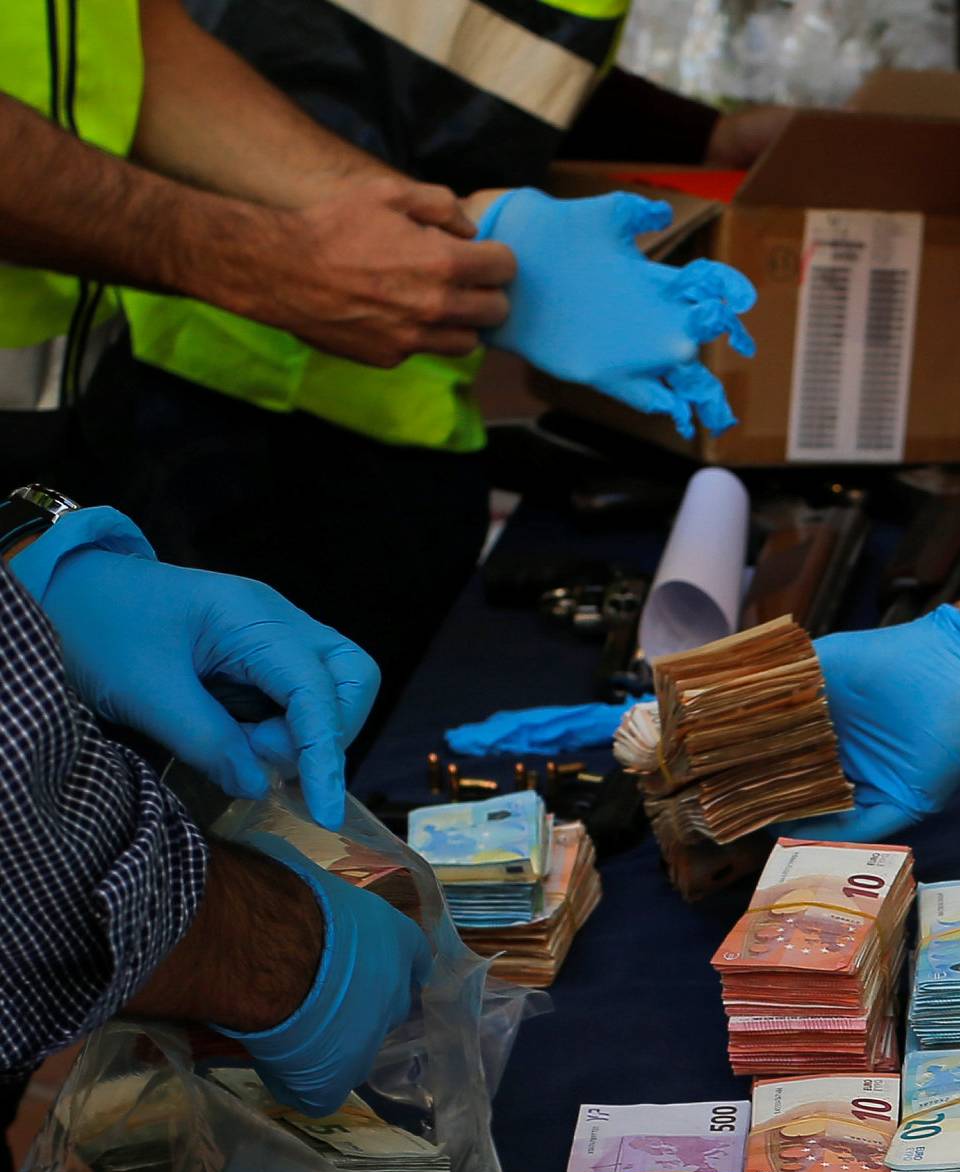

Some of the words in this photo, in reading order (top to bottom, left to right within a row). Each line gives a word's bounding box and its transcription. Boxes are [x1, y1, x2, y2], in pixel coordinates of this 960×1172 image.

[841, 873, 886, 900] 10
[863, 1079, 873, 1092] EURO
[709, 1105, 738, 1133] 500
[851, 1097, 894, 1122] 10
[900, 1112, 945, 1140] 20
[914, 1145, 926, 1161] EURO
